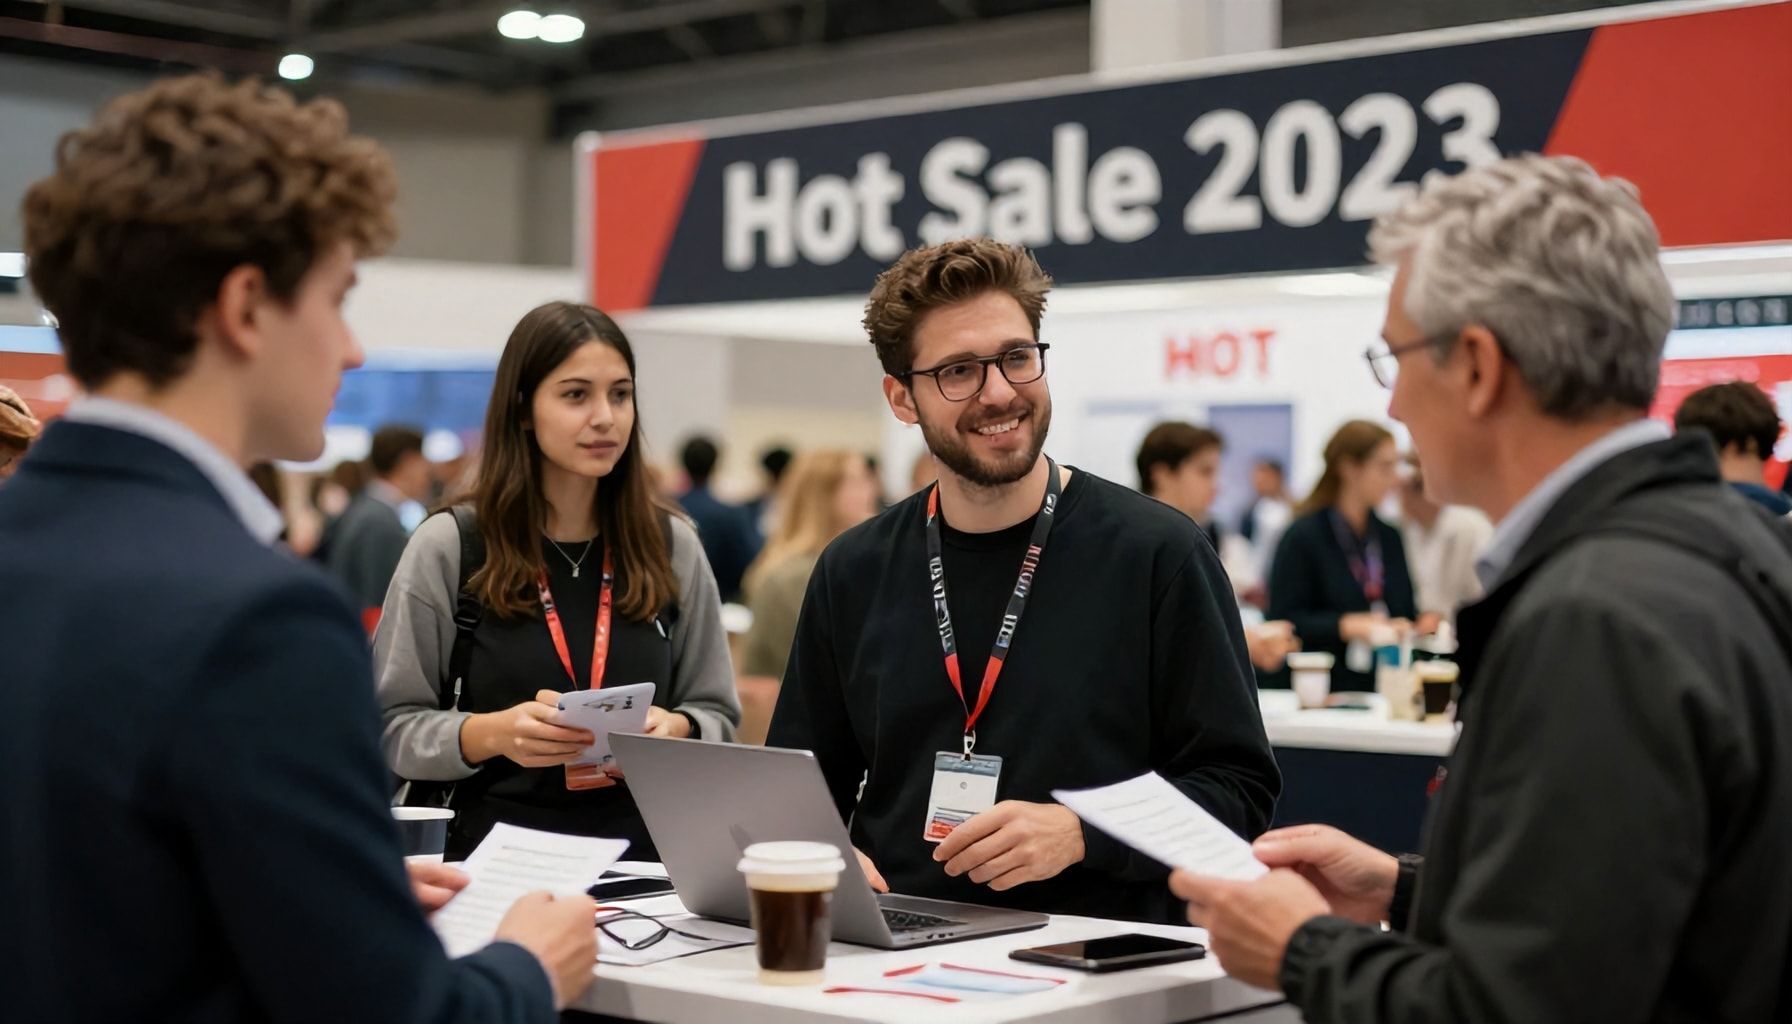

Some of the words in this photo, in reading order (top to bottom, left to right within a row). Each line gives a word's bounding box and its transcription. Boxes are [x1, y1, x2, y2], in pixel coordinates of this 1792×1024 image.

[723, 152, 905, 271] Hot
[918, 122, 1161, 247] Sale
[1164, 329, 1276, 382] HOT
